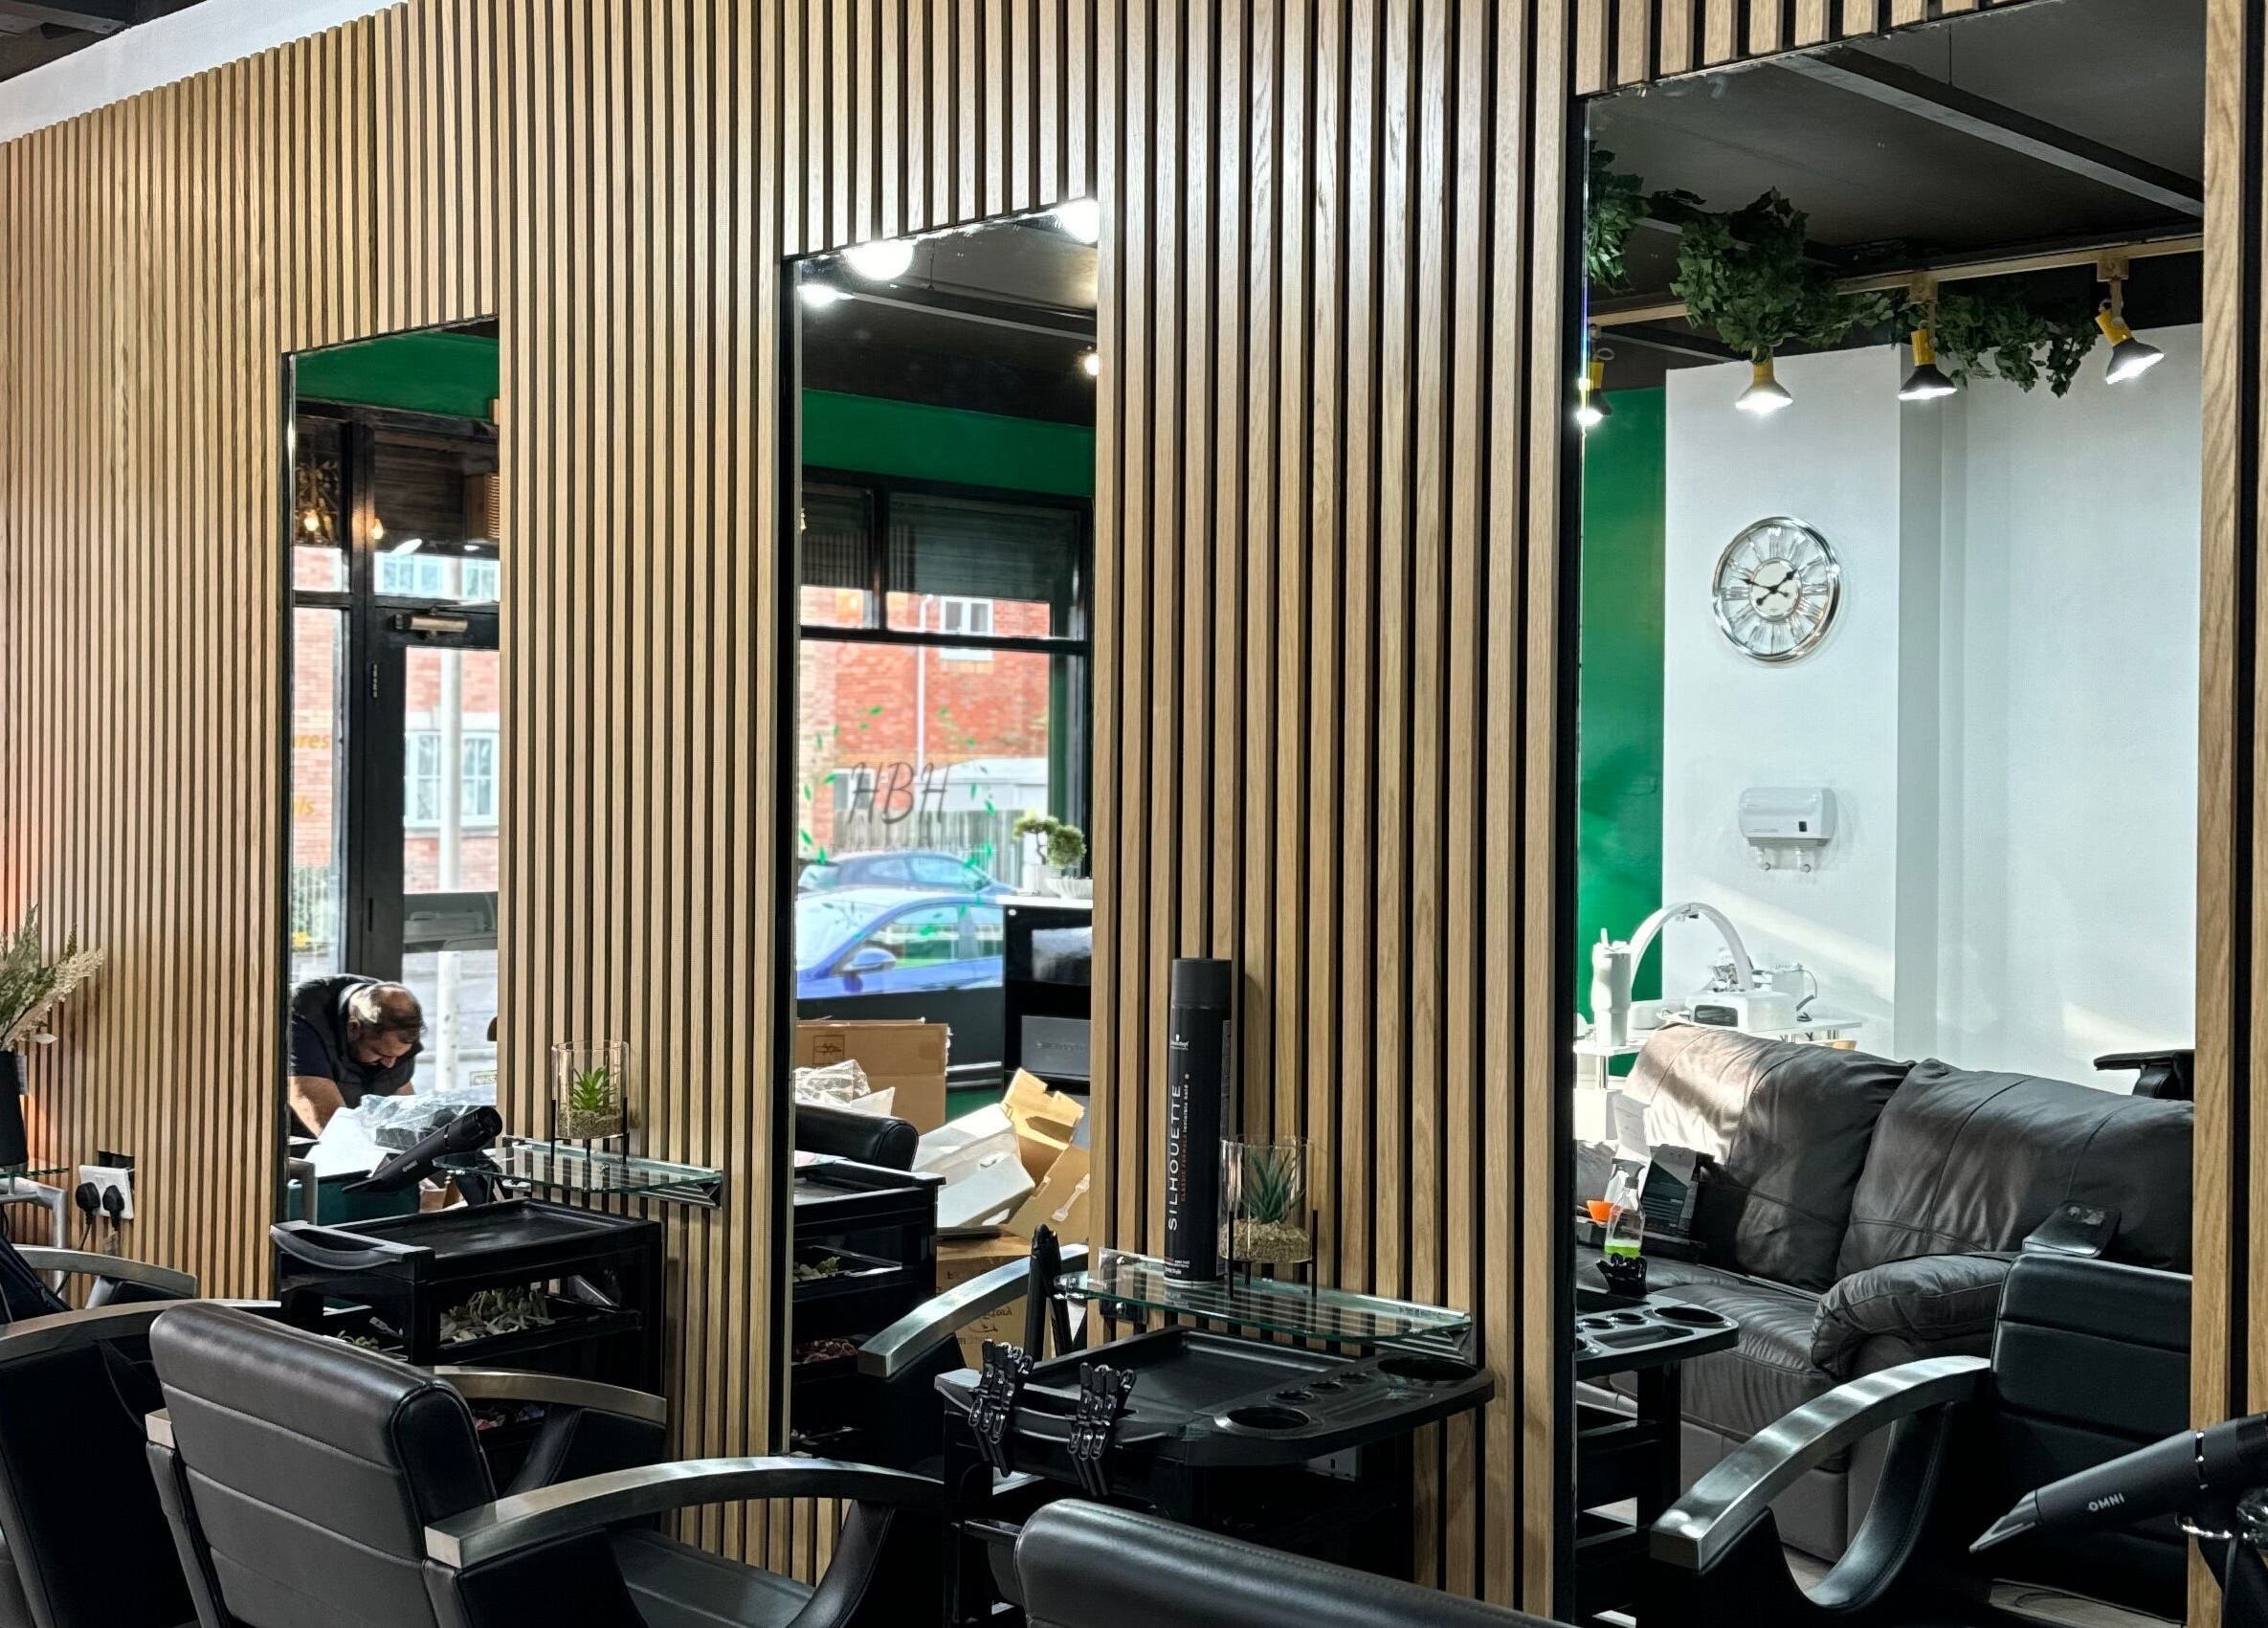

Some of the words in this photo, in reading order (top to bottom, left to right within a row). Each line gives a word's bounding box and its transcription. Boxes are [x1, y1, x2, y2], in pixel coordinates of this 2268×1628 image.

[847, 762, 951, 825] HBH
[1167, 1084, 1181, 1232] SILHOUETTE
[2088, 1492, 2125, 1512] OMNI
